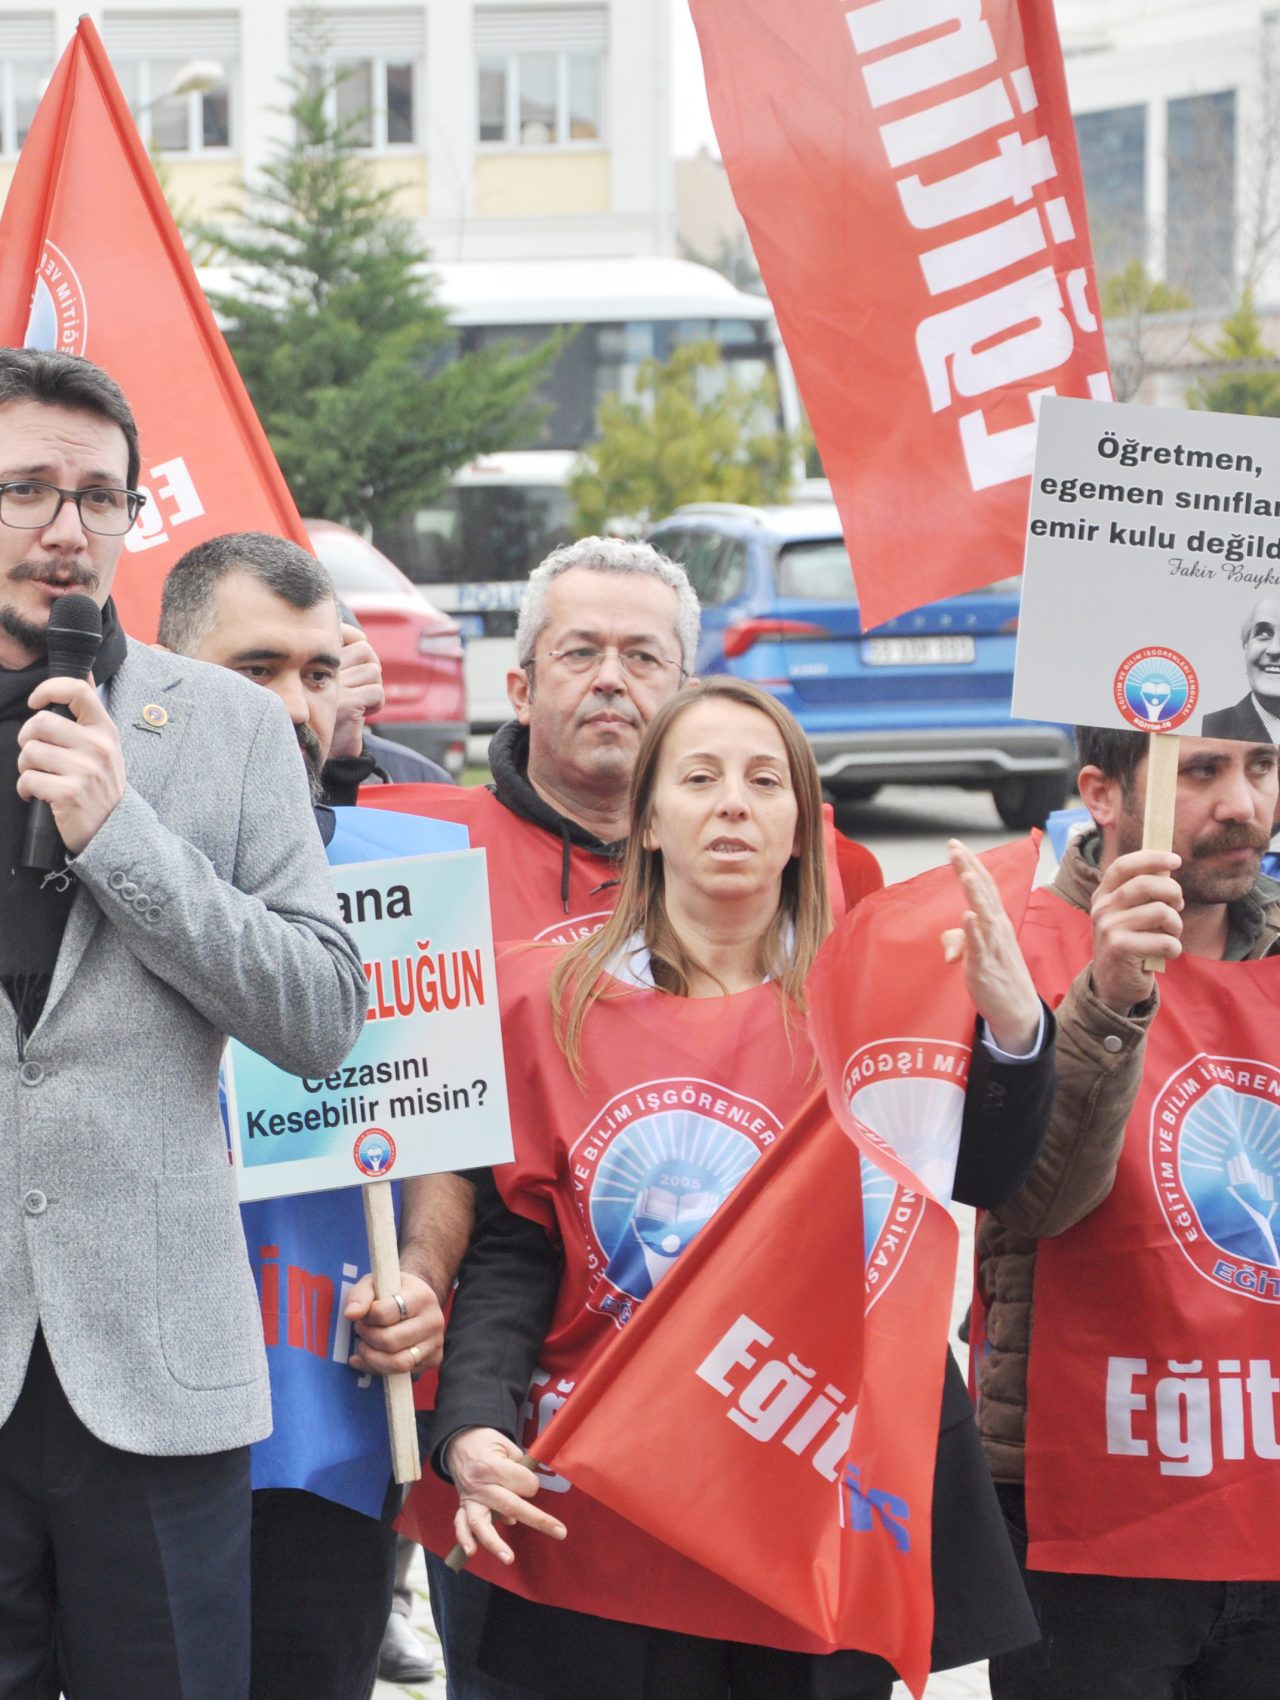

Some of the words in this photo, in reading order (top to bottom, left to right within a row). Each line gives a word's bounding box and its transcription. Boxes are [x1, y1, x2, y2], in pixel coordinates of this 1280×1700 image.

[1097, 431, 1263, 478] Öğretmen,
[1040, 477, 1164, 506] egemen
[1030, 518, 1100, 541] emir
[1109, 522, 1176, 550] kulu
[1168, 557, 1217, 579] Fakir
[336, 884, 412, 925] ana
[246, 1096, 379, 1139] Kesebilir
[389, 1079, 488, 1118] misin?
[1161, 1077, 1201, 1125] BİLİM
[583, 1104, 633, 1162] BİLİM
[635, 1085, 776, 1147] İŞGÖRENLER
[1159, 1127, 1174, 1154] VE
[659, 1174, 701, 1189] 2005
[1160, 1162, 1199, 1243] EĞİTİM
[695, 1313, 858, 1483] Eğit
